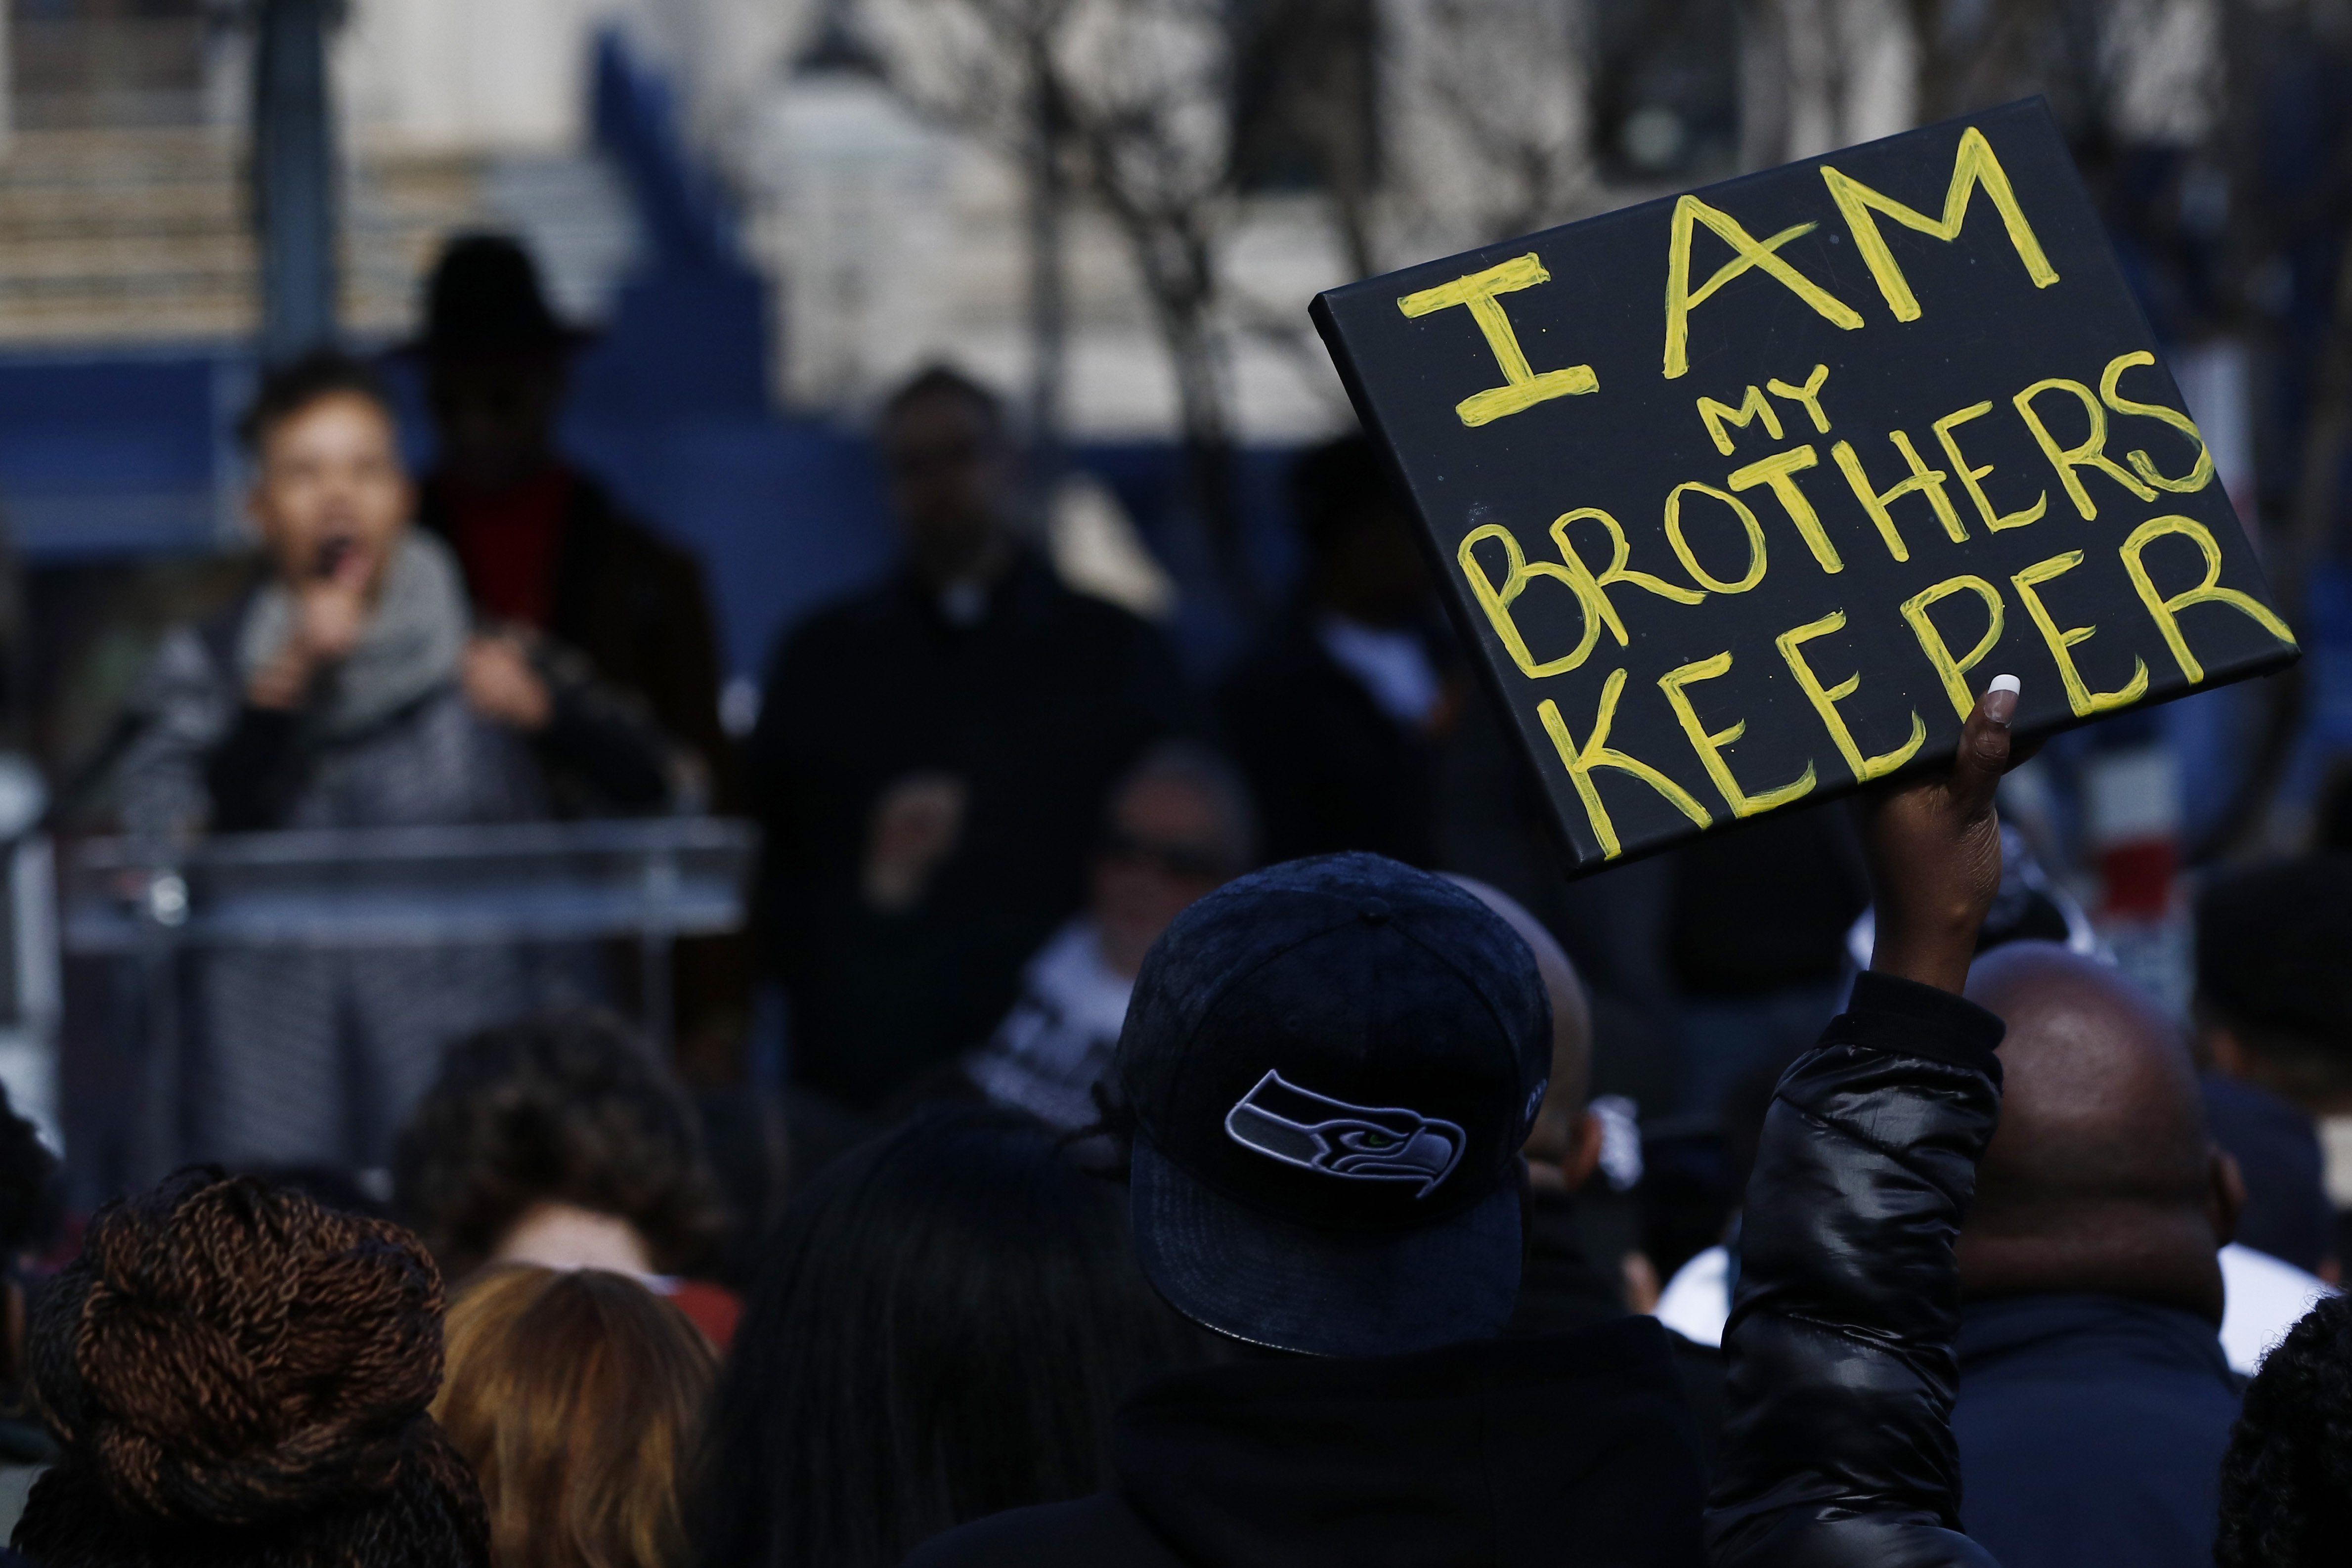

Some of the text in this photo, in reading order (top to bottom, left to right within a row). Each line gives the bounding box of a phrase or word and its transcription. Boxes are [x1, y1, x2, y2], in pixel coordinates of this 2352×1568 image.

[1396, 126, 2061, 428] I AM
[1696, 363, 1831, 456] MY
[1457, 350, 2214, 679] BROTHERS
[1536, 515, 2298, 860] KEEPER
